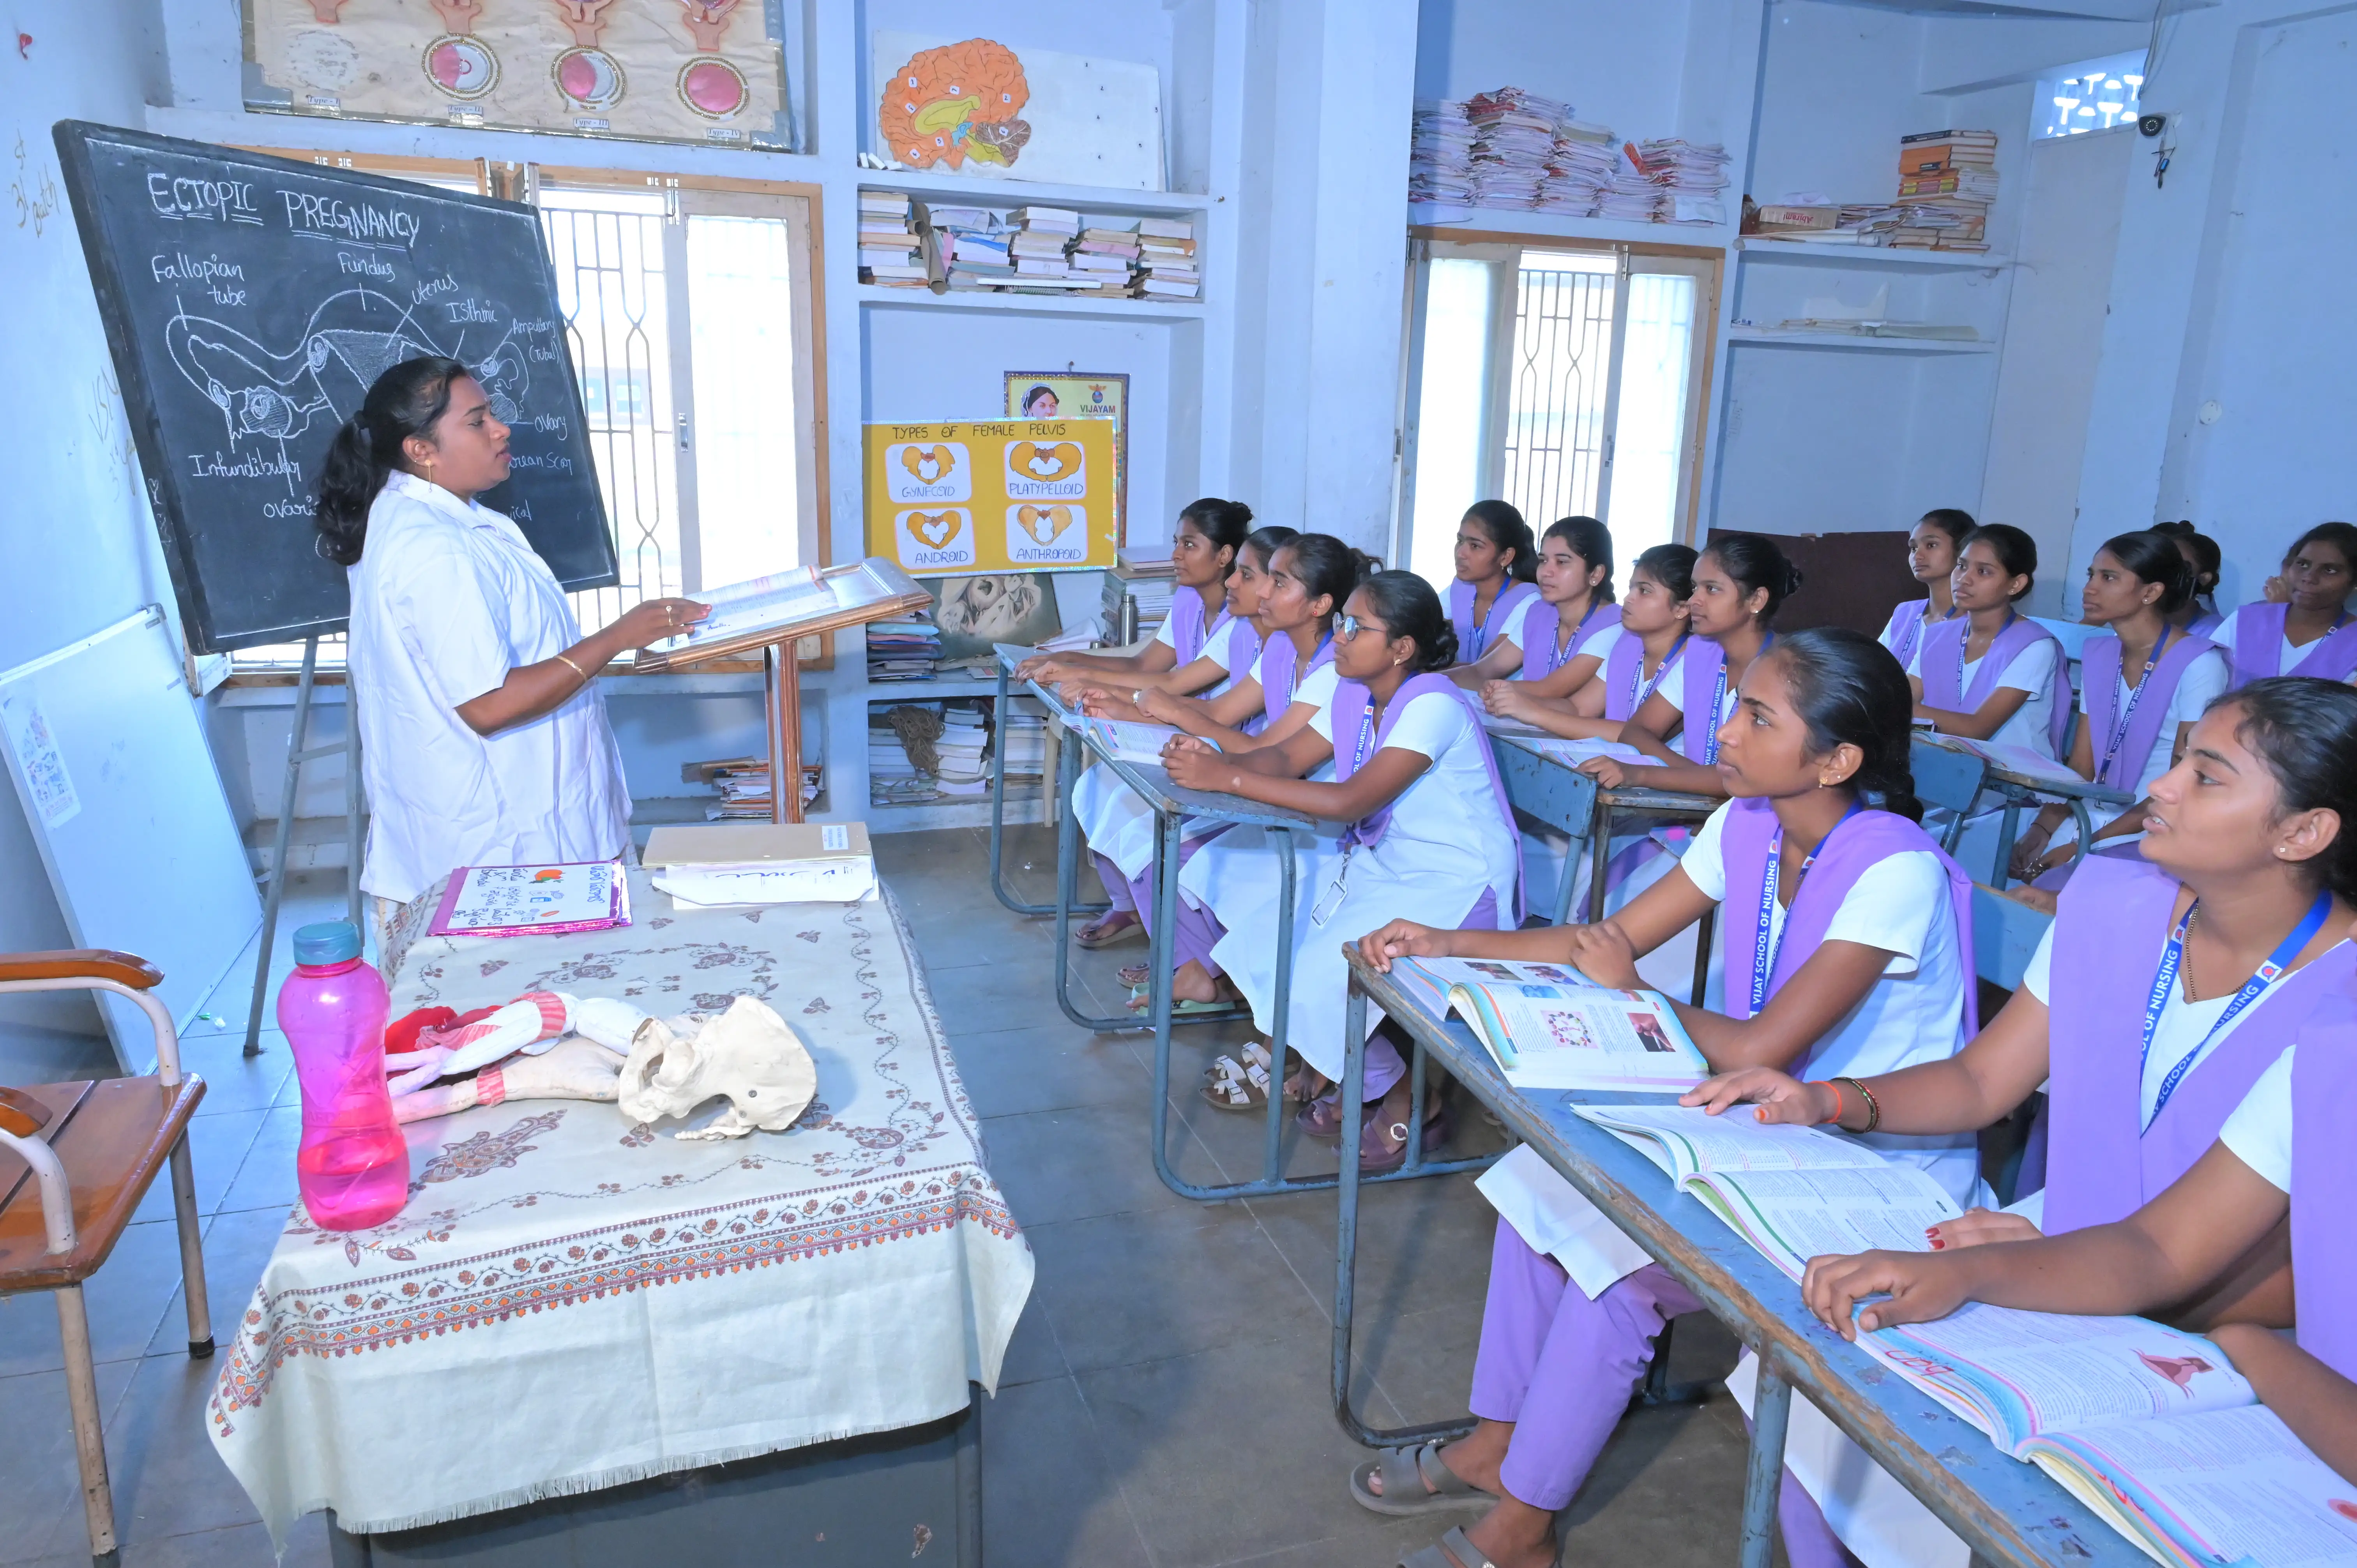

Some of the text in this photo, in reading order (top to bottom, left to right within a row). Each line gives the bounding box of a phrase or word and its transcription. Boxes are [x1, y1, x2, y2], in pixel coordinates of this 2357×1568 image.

[147, 172, 420, 249] ECTOPIC PREGNANCY
[151, 253, 244, 284] Fallopian
[340, 252, 396, 282] Fundus
[207, 285, 247, 307] tube
[512, 318, 556, 342] Ampullary
[529, 341, 560, 364] (Tubal)
[1080, 404, 1115, 413] VIJAYAM
[892, 423, 1066, 440] TYPES OF FEMALE PELVIS
[546, 452, 573, 476] Scar
[1009, 483, 1083, 495] PLATYPELLOID
[915, 550, 968, 564] ANDROID
[1016, 548, 1081, 560] ANTHROPOID
[1564, 635, 1575, 659] NURSING
[1631, 664, 1641, 690] NURSING
[1643, 672, 1659, 702] NURSING
[1705, 676, 1724, 765] VIJAY SCHOOL OF NURSING
[2113, 673, 2148, 750] VIJAY SCHOOL OF NURSING
[1358, 719, 1369, 750] NURSING
[1355, 751, 1362, 763] OF
[1753, 860, 1777, 1005] VIJAY SCHOOL OF NURSING
[2144, 949, 2179, 1031] OF NURSING
[2159, 1055, 2192, 1103] SCHOOL
